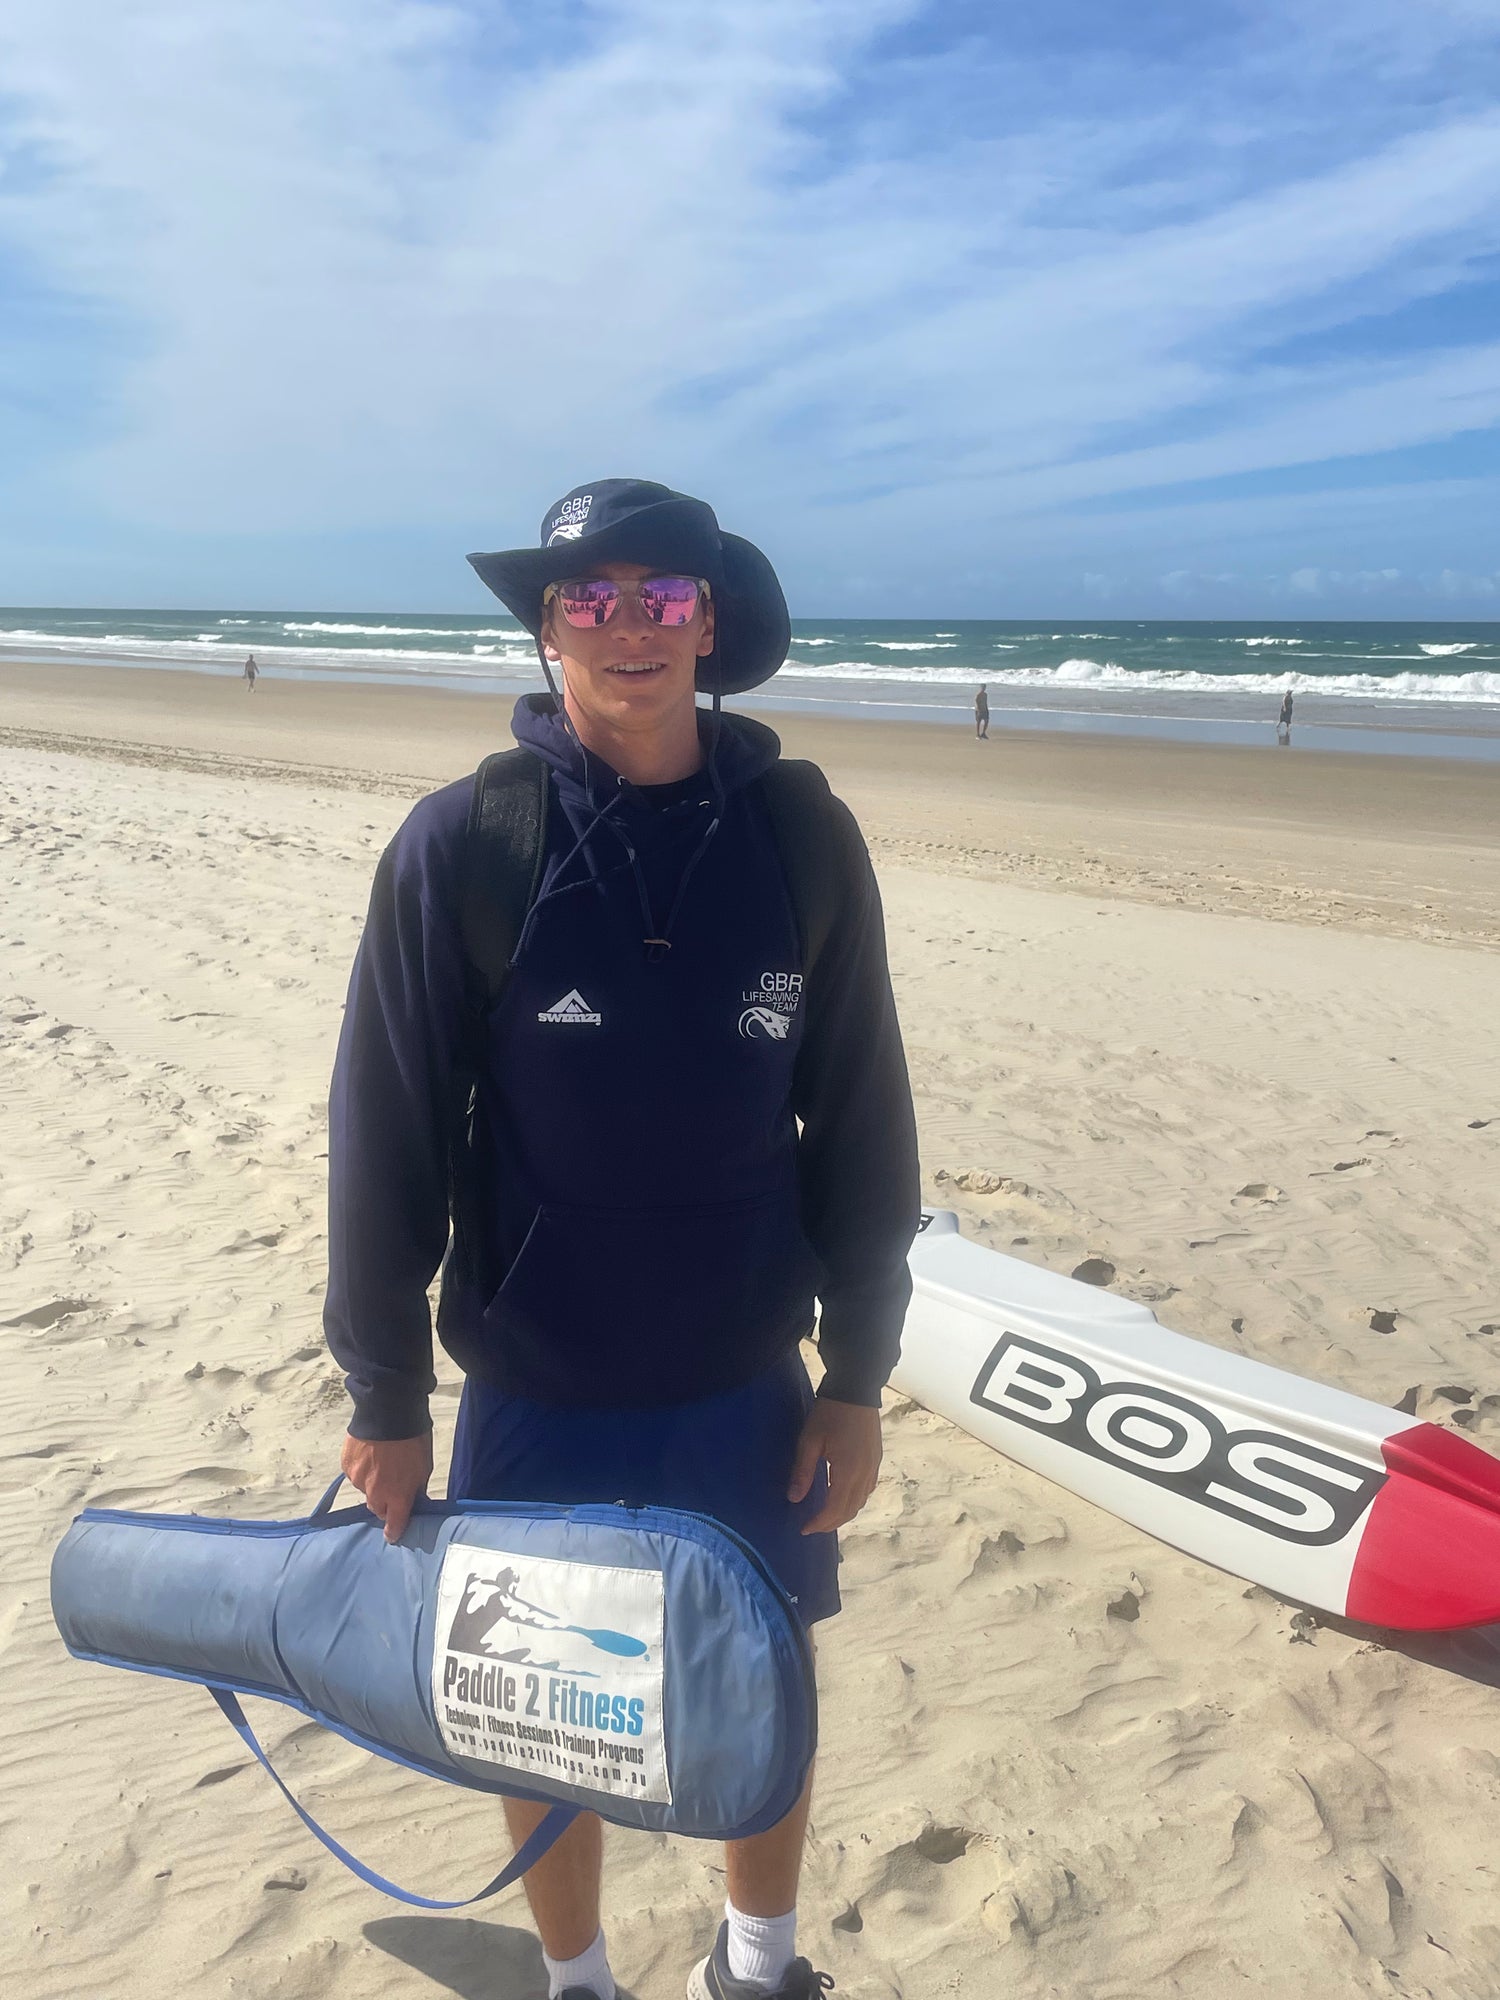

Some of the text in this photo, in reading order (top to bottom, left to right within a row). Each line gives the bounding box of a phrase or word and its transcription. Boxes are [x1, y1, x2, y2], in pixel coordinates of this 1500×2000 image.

[561, 494, 593, 515] GBR
[760, 971, 803, 993] GBR
[742, 990, 800, 1003] LIFESAVING
[772, 1002, 798, 1012] TEAM
[979, 1341, 1367, 1535] BOS
[443, 1655, 645, 1737] Paddle 2 Fitness
[444, 1704, 481, 1731] Technique
[486, 1714, 516, 1738] Fitness
[516, 1720, 554, 1746] Sessions
[554, 1729, 561, 1748] &
[561, 1731, 596, 1760] Training
[598, 1738, 644, 1765] Programs
